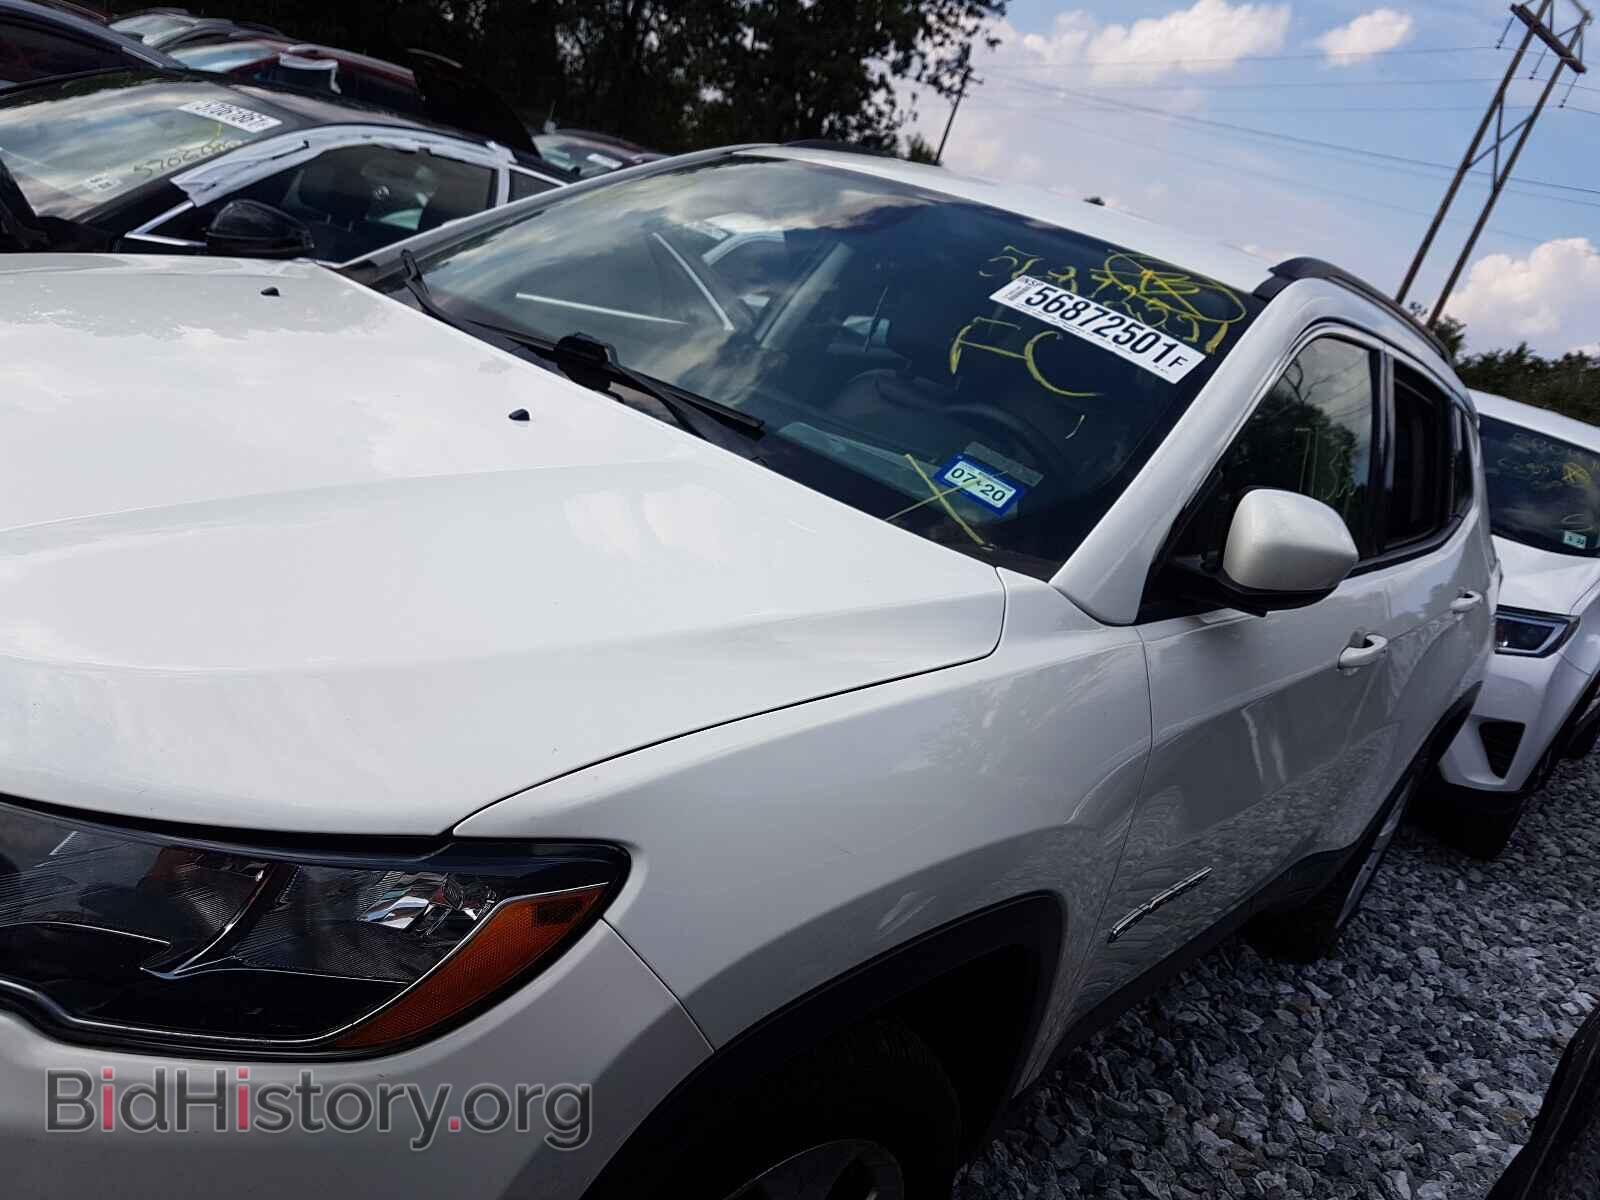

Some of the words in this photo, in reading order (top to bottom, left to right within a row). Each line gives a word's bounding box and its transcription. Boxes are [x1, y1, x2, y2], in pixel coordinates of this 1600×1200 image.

[1023, 287, 1179, 364] 56872501
[1168, 356, 1189, 368] F
[951, 468, 977, 483] 07
[979, 484, 1006, 501] 20
